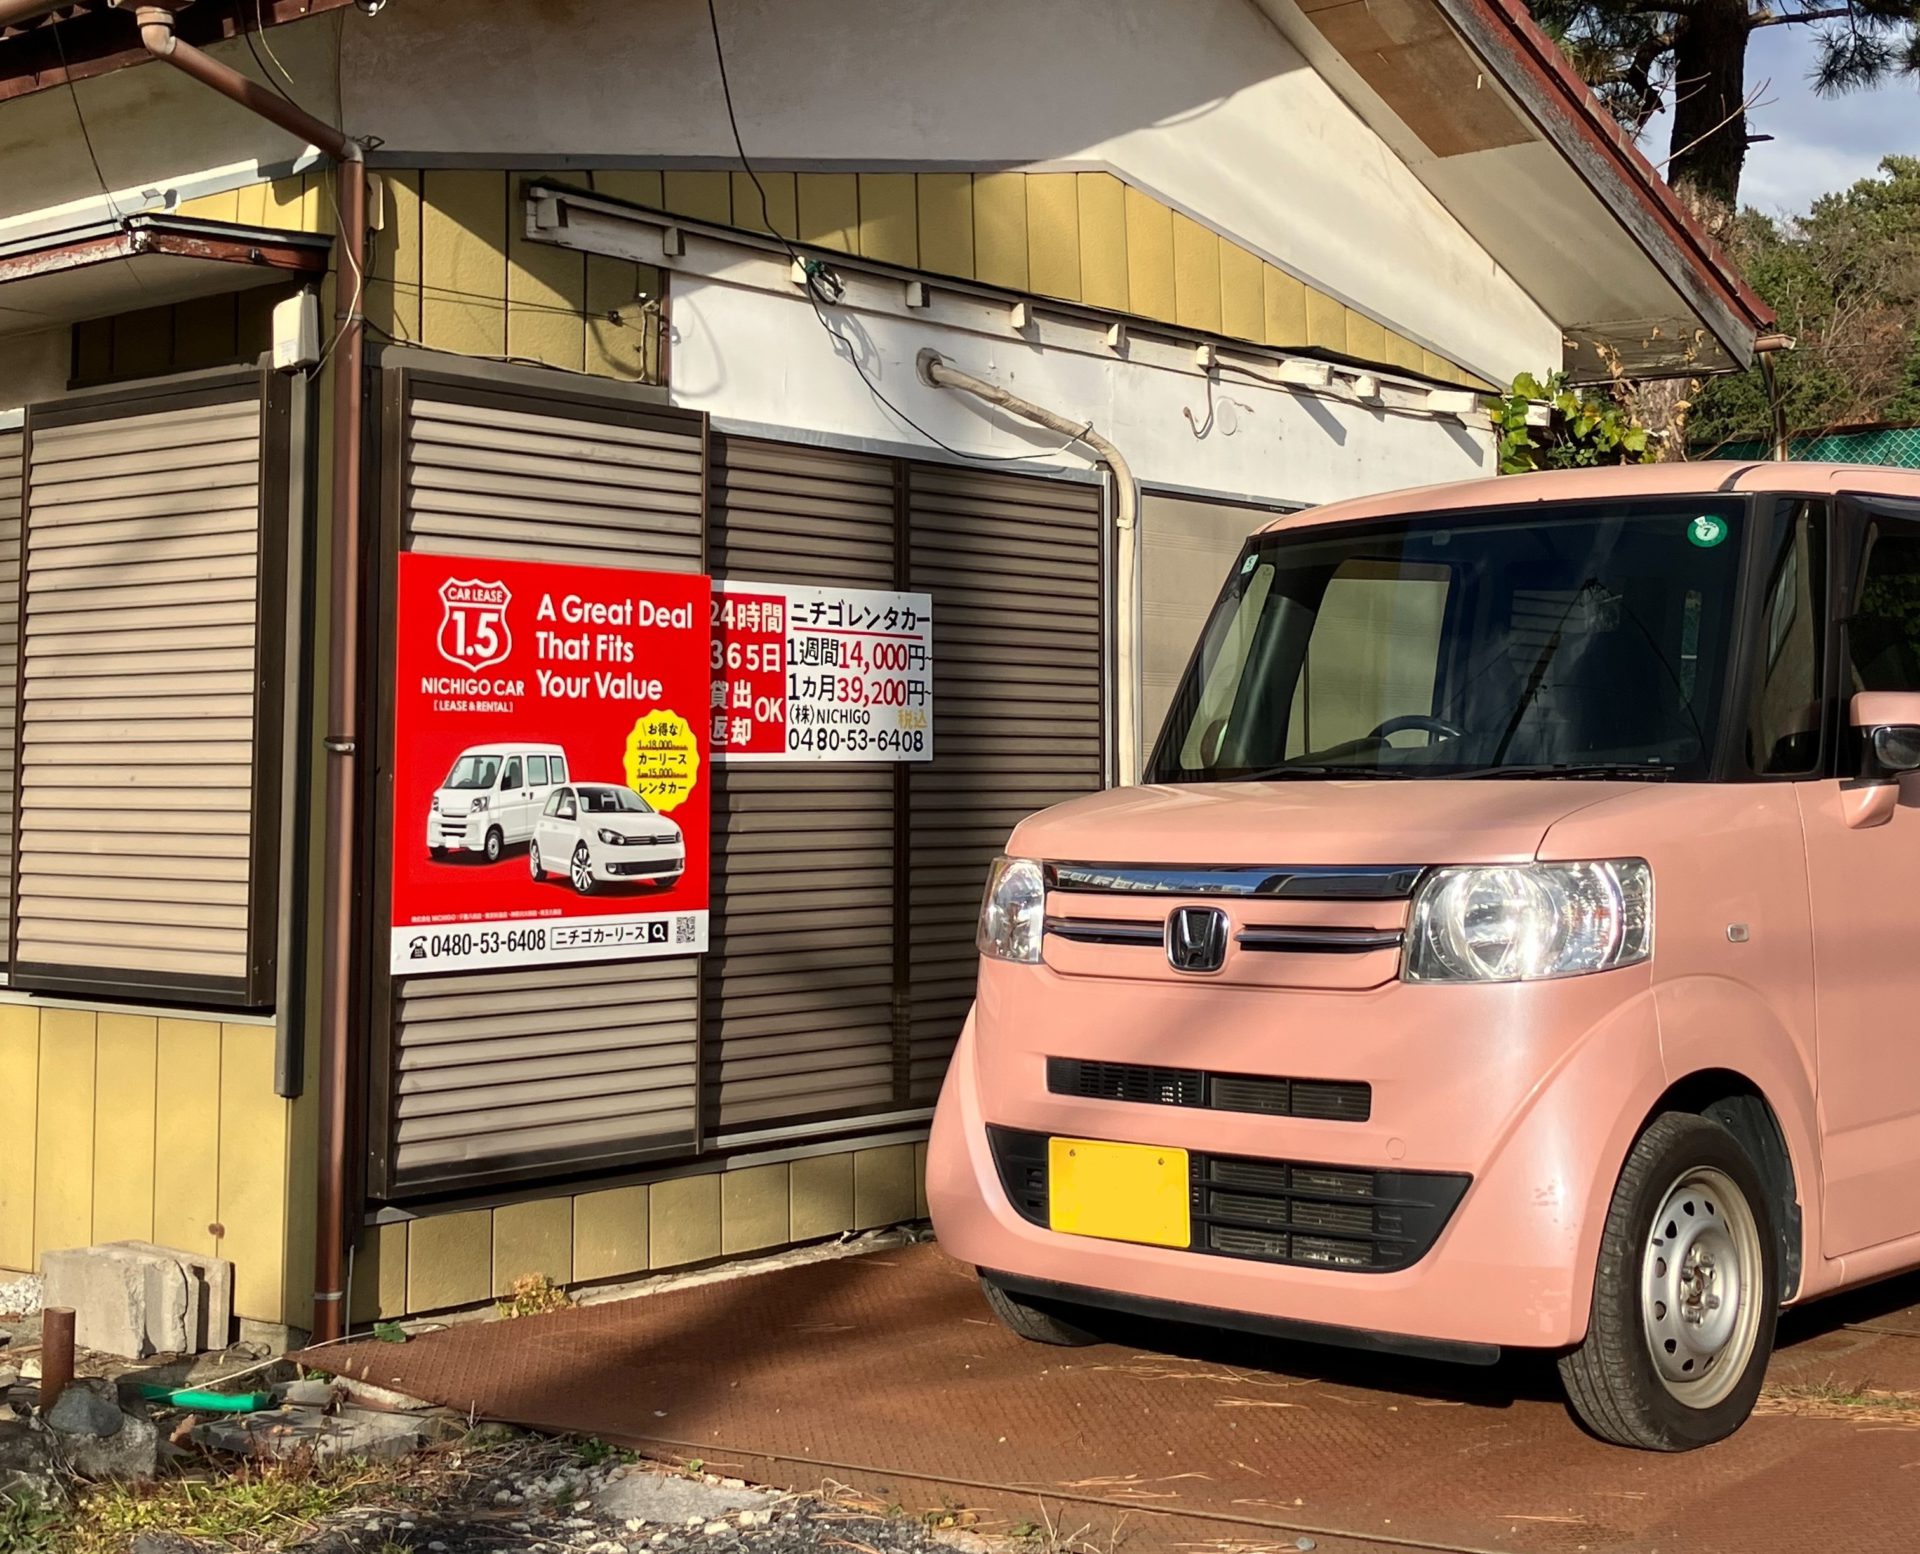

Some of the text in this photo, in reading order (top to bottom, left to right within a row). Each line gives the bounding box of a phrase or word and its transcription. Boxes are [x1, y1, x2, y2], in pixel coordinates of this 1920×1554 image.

[448, 588, 503, 603] CAR LEASE
[536, 593, 693, 629] A Great Deal
[711, 599, 783, 633] 24時間
[791, 599, 931, 631] ニチゴレンタカー
[452, 610, 499, 658] 1.5
[536, 631, 634, 663] That Fits
[711, 639, 781, 673] 365日
[421, 677, 525, 696] NICHIGO CAR
[536, 669, 663, 701] Your Value
[710, 679, 752, 709] 貸出
[754, 696, 784, 723] OK
[897, 708, 928, 729] 税込
[648, 722, 678, 736] お得な
[709, 716, 752, 746] 返却
[788, 727, 924, 752] 0480-53-6408
[638, 752, 687, 766] カーリース
[638, 781, 688, 795] レンタカー
[431, 928, 546, 957] 0480-53-6408
[556, 926, 645, 945] ニチゴカーリース
